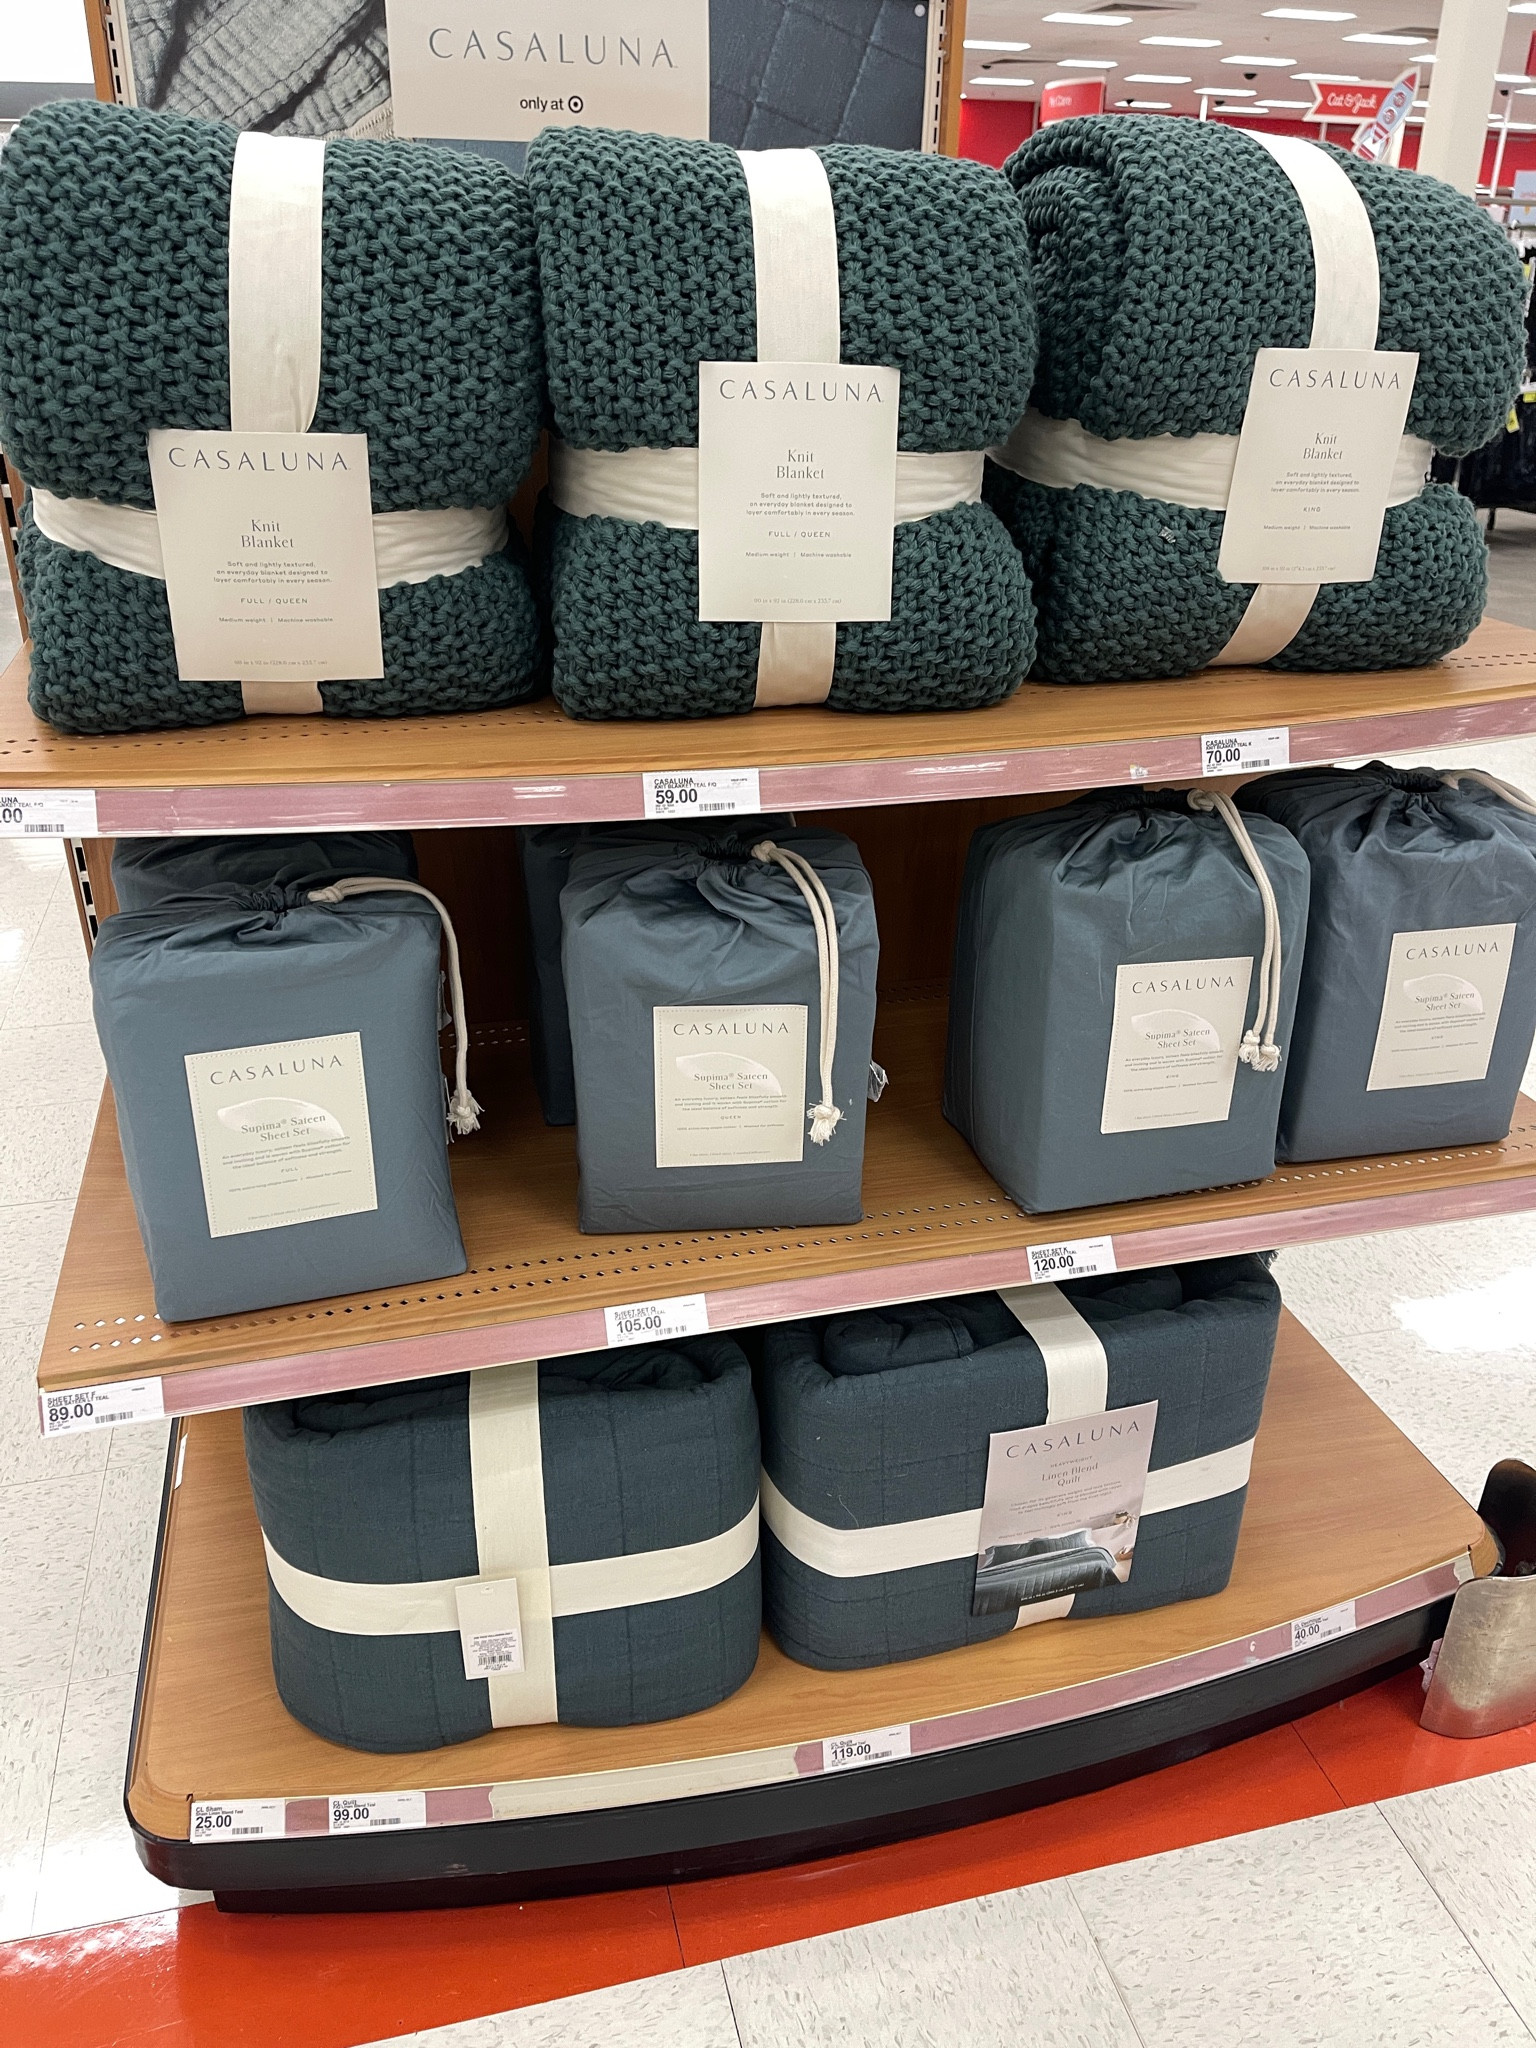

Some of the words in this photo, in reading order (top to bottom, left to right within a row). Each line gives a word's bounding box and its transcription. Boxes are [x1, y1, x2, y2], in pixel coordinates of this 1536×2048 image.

[429, 28, 673, 68] CASALUNA
[520, 97, 548, 112] only
[550, 99, 564, 110] at
[1270, 369, 1400, 389] CASALUNA
[720, 380, 881, 402] CASALUNA
[1315, 433, 1336, 444] Knit
[168, 448, 348, 471] CASALUNA
[788, 450, 814, 462] Knit
[1303, 448, 1343, 459] Blanket
[776, 466, 824, 478] Blanket
[252, 519, 280, 532] Knit
[241, 535, 294, 548] Blanket
[1207, 748, 1240, 763] 70.00
[656, 789, 697, 804] 59.00
[1406, 942, 1499, 960] CASALUNA
[1132, 976, 1234, 993] CASALUNA
[1426, 1003, 1447, 1012] Sheet
[674, 1023, 789, 1035] CASALUNA
[1157, 1040, 1180, 1049] Sheet
[210, 1055, 342, 1084] CASALUNA
[290, 1114, 326, 1126] Sateen
[260, 1129, 290, 1142] Sheet
[293, 1127, 310, 1136] Set
[1034, 1256, 1074, 1271] 120.00
[617, 1316, 661, 1333] 105.00
[48, 1395, 73, 1403] SHEET
[49, 1403, 93, 1422] 89.00
[1007, 1421, 1139, 1458] CASALUNA
[1042, 1471, 1068, 1482] Linen
[1071, 1464, 1098, 1474] Blend
[1057, 1476, 1081, 1486] Quilt
[1295, 1624, 1319, 1639] 40.00
[832, 1744, 871, 1760] 119.00
[196, 1815, 232, 1828] 25.00
[334, 1808, 369, 1821] 99.00
